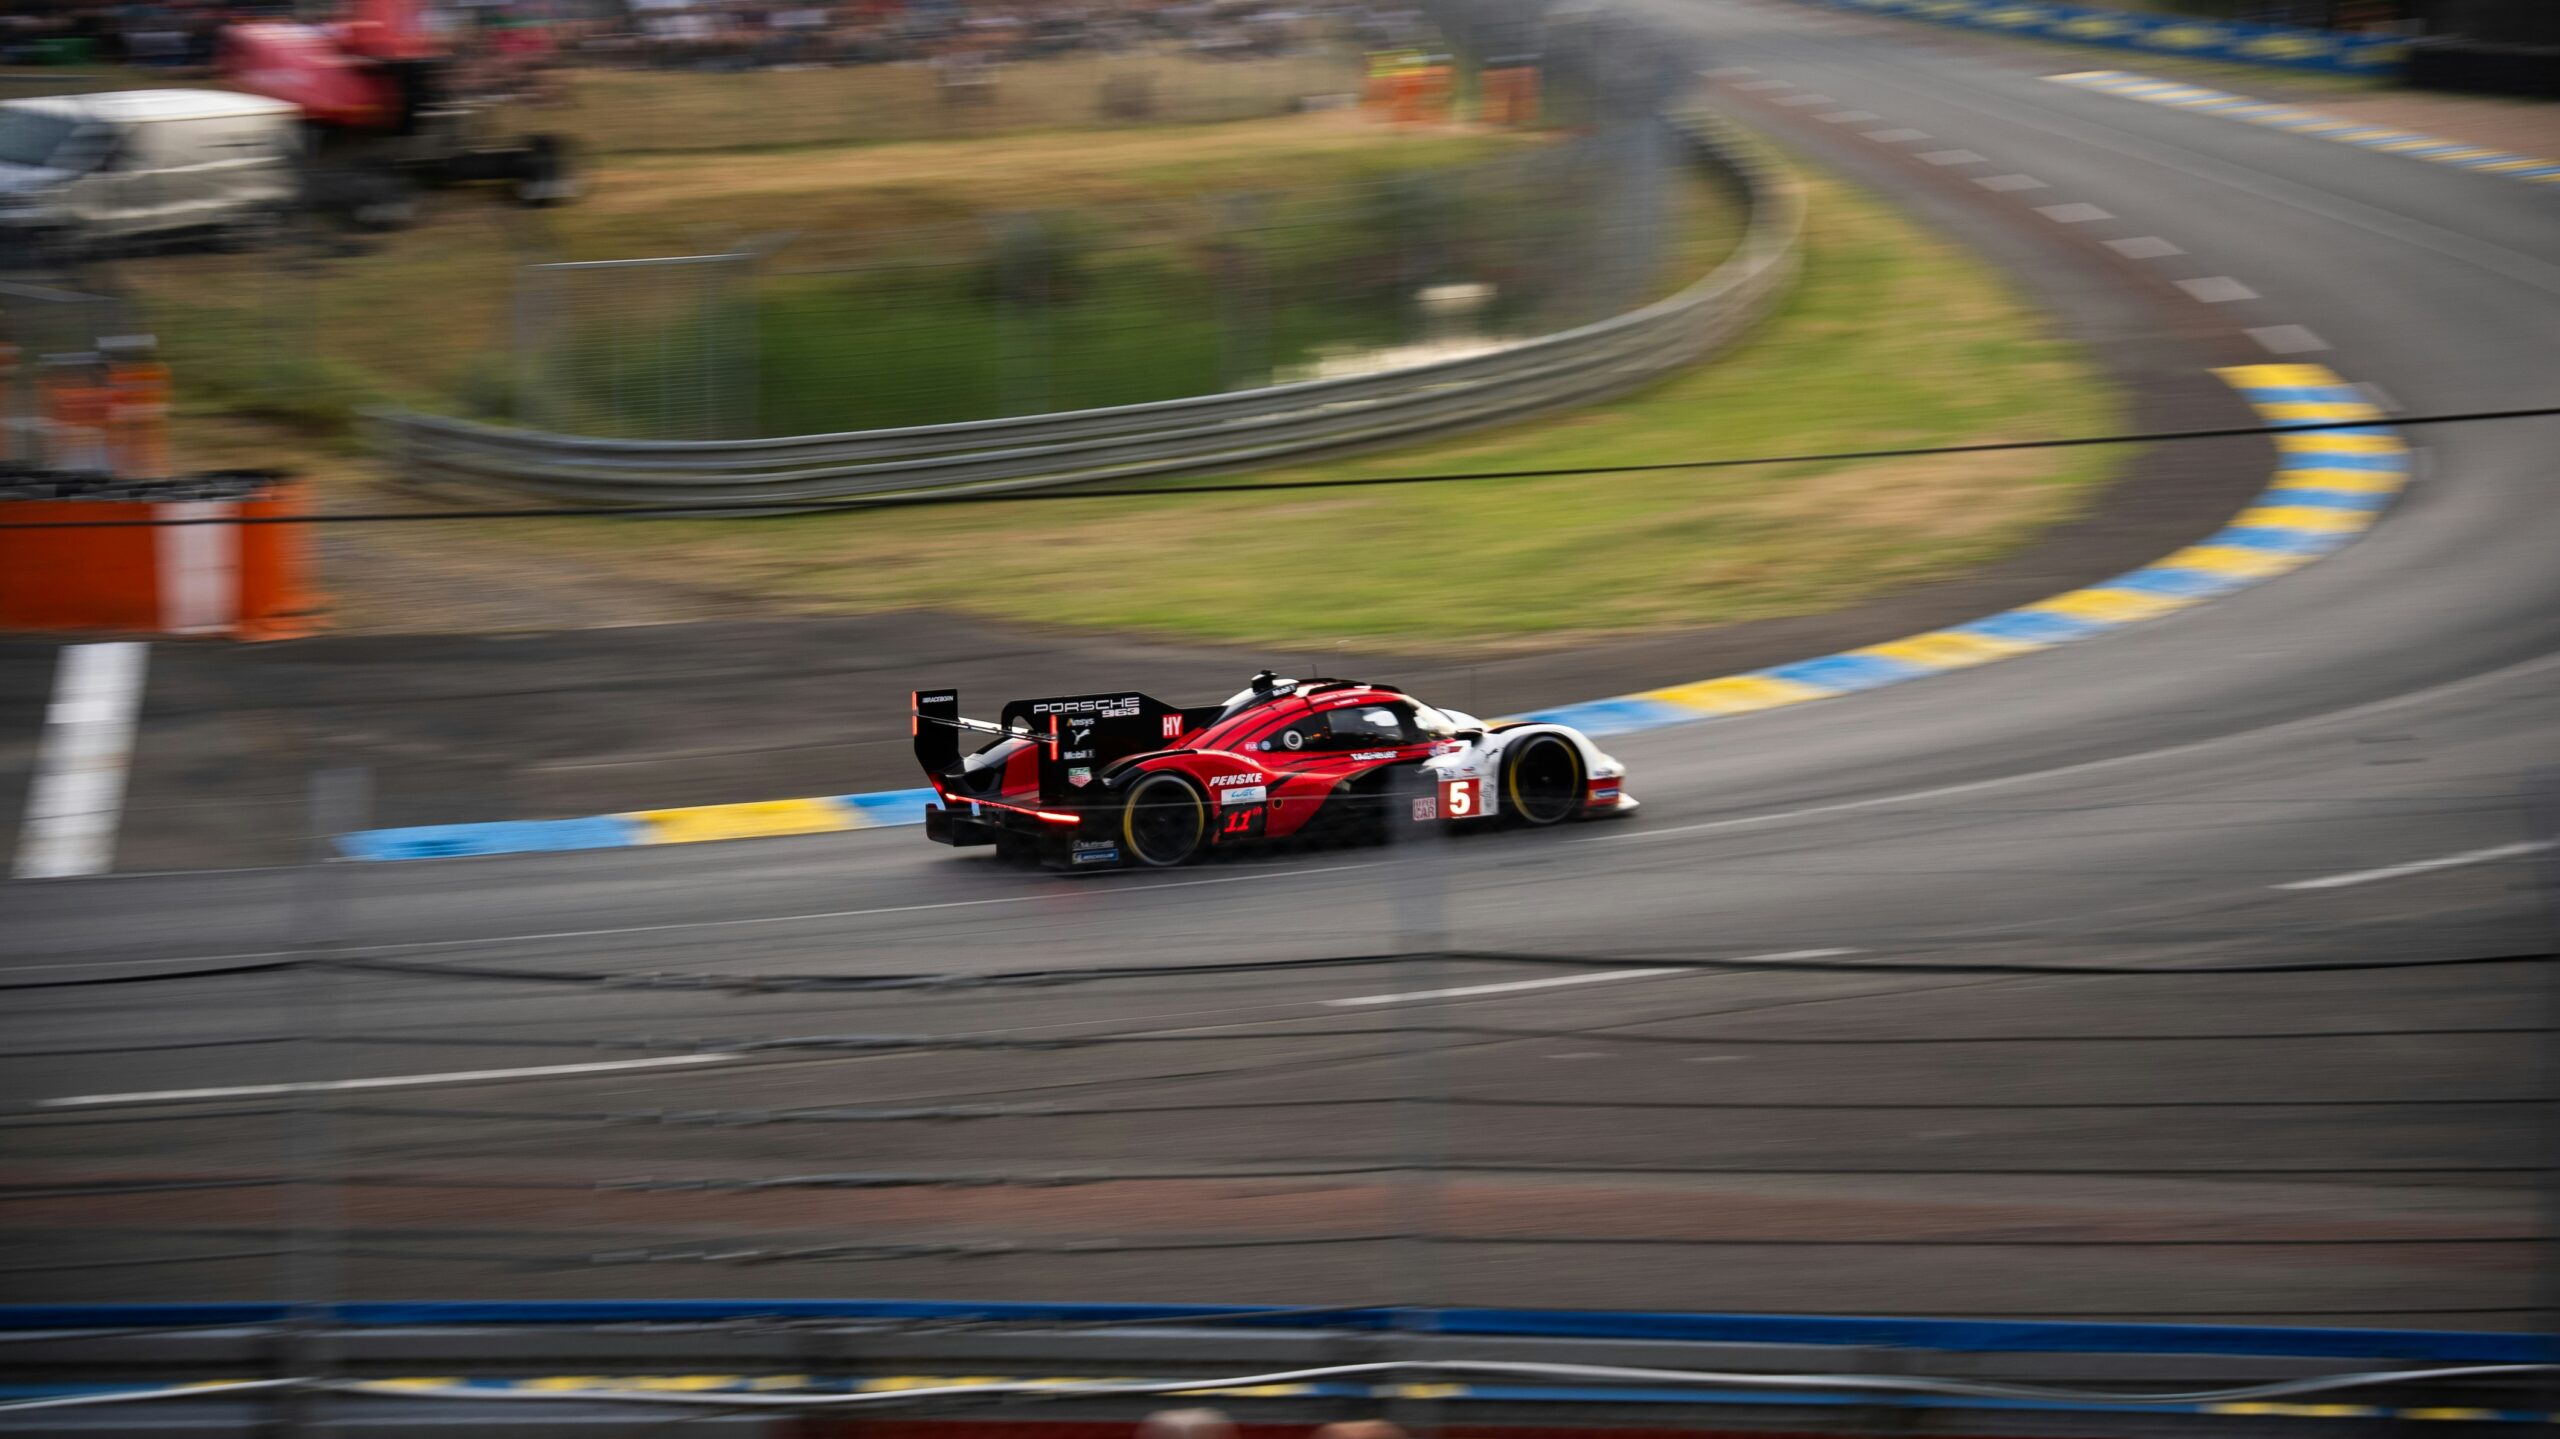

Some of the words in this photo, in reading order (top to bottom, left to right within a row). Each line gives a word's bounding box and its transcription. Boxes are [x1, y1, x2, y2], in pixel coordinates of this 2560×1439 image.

[1033, 697, 1140, 714] PORSCHE
[1102, 707, 1140, 718] 963
[1162, 716, 1183, 737] HY
[1209, 773, 1262, 787] PENSKE
[1449, 781, 1471, 815] 5
[1414, 807, 1435, 819] CAR
